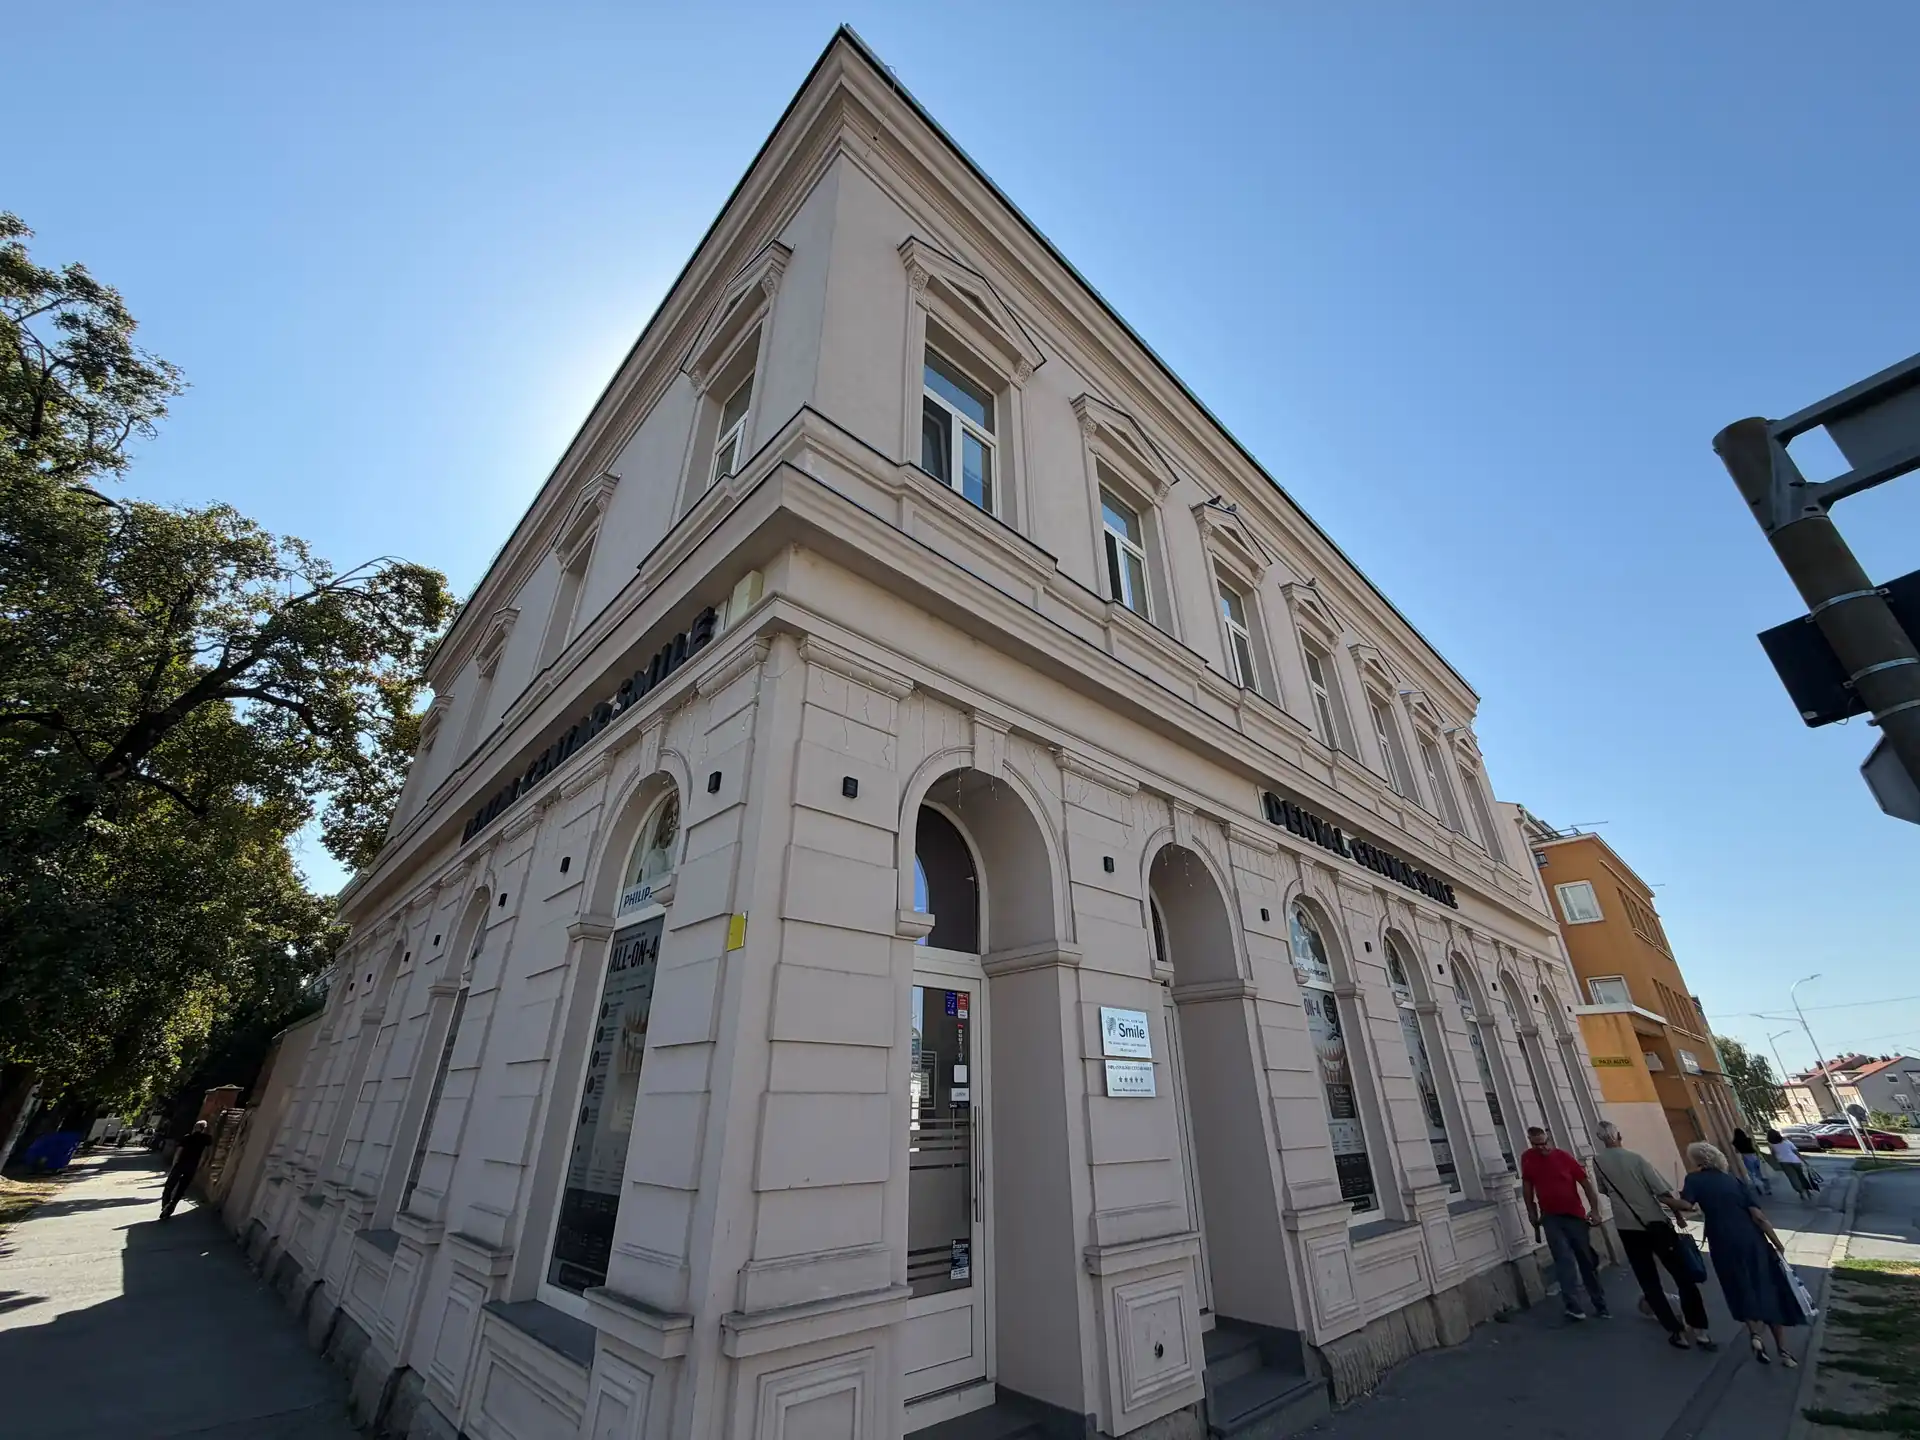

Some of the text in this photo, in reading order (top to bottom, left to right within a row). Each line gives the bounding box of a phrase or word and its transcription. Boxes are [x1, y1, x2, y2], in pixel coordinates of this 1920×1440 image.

[611, 606, 716, 721] SMILE
[1264, 791, 1351, 859] DENTAL
[623, 886, 653, 909] PHILIP
[1118, 1023, 1145, 1039] Smile
